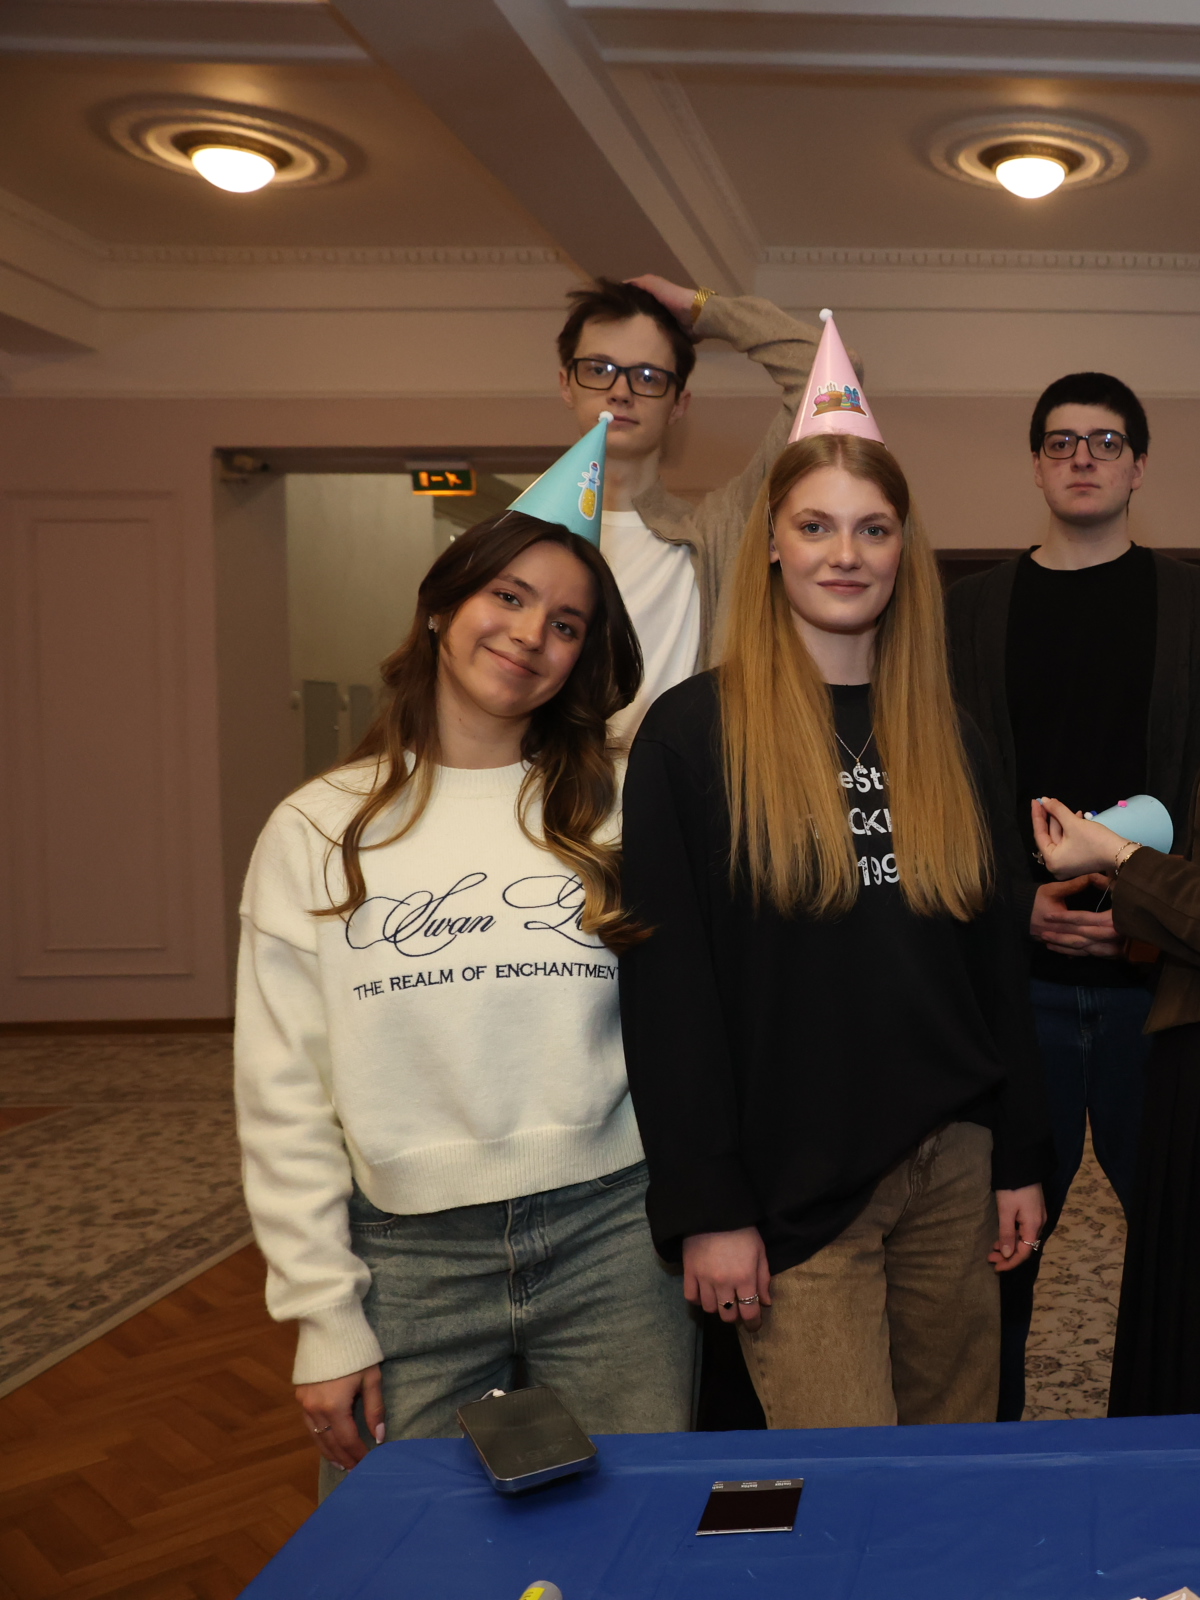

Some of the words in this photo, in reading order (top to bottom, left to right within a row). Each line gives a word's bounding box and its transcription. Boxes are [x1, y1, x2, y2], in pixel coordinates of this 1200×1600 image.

[838, 766, 889, 793] eSt
[345, 872, 496, 957] Swan
[353, 980, 385, 1000] THE
[389, 969, 454, 992] REALM
[462, 965, 488, 982] OF
